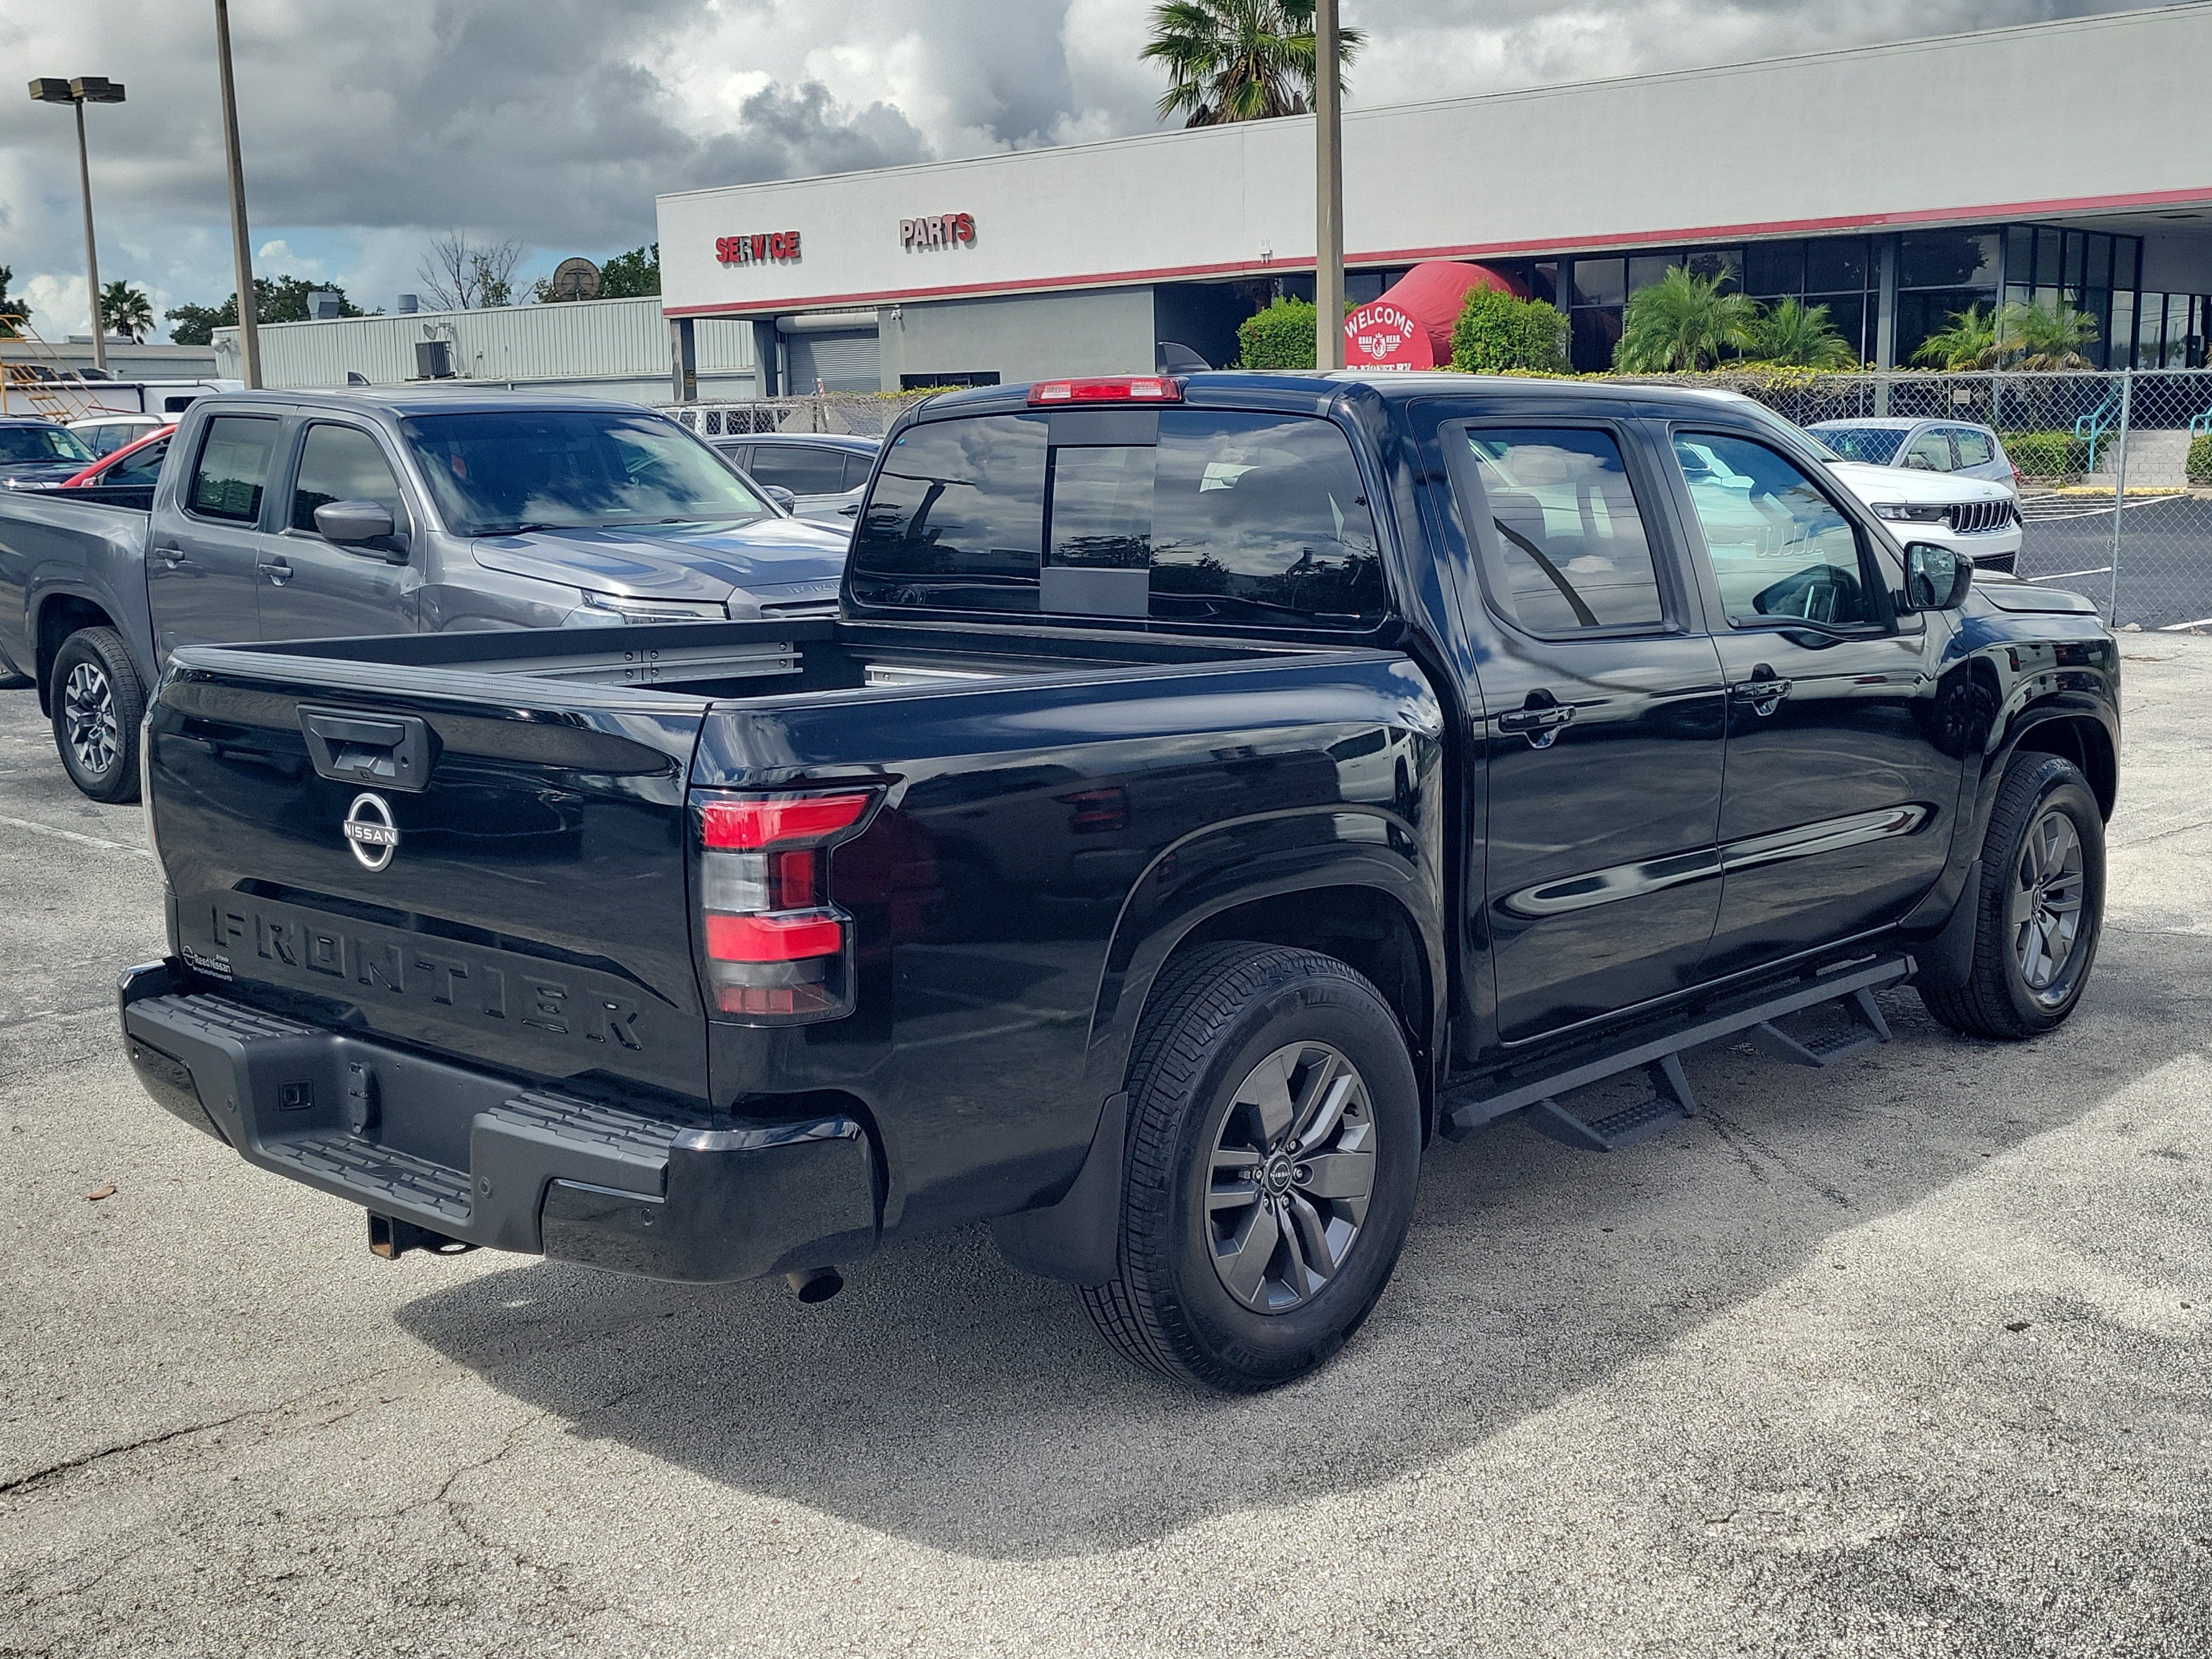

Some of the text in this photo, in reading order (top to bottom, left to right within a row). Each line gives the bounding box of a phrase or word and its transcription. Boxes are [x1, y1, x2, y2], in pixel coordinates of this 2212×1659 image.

[900, 213, 974, 247] PARTS
[716, 230, 801, 262] SERVICE
[1345, 307, 1414, 338] WELCOME
[344, 822, 396, 844] NISSAN
[210, 958, 231, 973] Nissan
[212, 904, 641, 1051] FRONTIER
